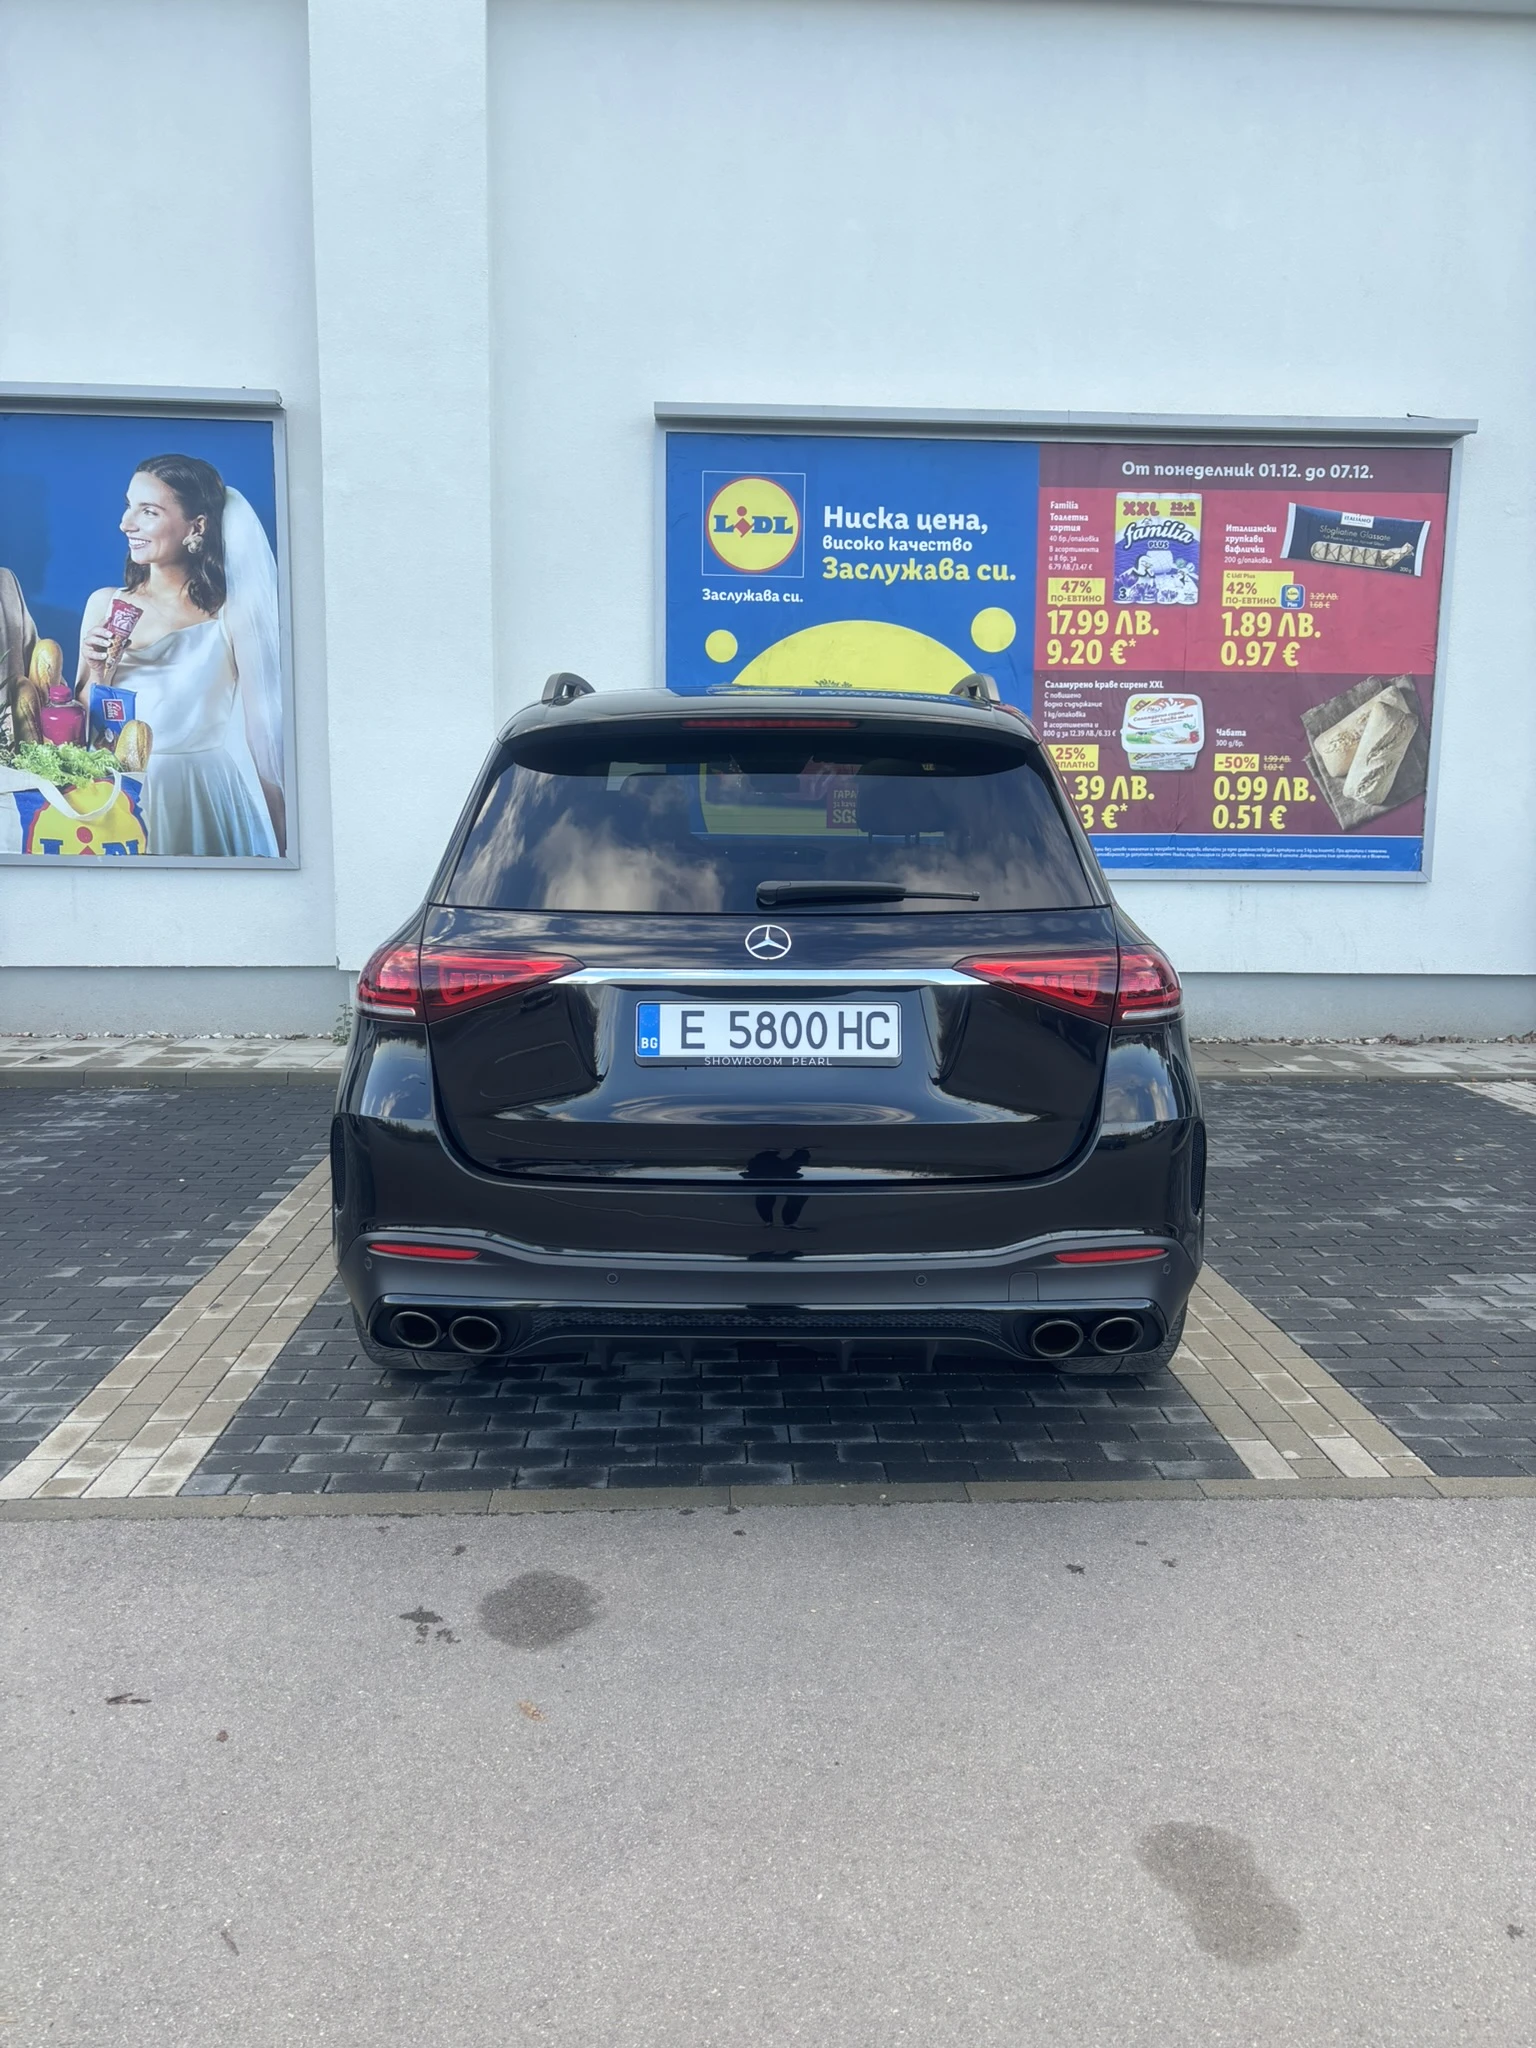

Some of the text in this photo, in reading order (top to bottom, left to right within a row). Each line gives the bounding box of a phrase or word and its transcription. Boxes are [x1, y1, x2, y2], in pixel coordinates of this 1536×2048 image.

[1122, 461, 1374, 481] От понеделник 01.12. до 07.12.
[1050, 501, 1079, 509] Familia
[1123, 501, 1160, 516] XXL
[823, 505, 988, 534] Ниска цена,
[1049, 513, 1089, 521] Тоалетна
[1049, 525, 1081, 533] хартия
[1124, 520, 1194, 550] familia
[1225, 524, 1277, 532] Италиански
[822, 535, 973, 552] високо качество
[1148, 541, 1170, 549] PLUS
[1225, 535, 1263, 544] хрупкави
[1225, 544, 1265, 554] вафлички
[822, 556, 1016, 585] Заслужава си.
[1061, 580, 1092, 594] 47%
[1226, 581, 1257, 595] 42%
[702, 588, 804, 604] Заслужава си.
[1225, 597, 1277, 605] ПО-ЕВТИНО
[1047, 609, 1160, 636] 17.99 ЛВ.
[1221, 611, 1321, 638] 1.89 ЛВ.
[1047, 639, 1103, 665] 9.20
[1220, 640, 1301, 667] 0.97 €
[1044, 680, 1164, 690] Саламурено краве сирене XXL
[1216, 728, 1246, 736] Чабата
[1055, 747, 1086, 760] 25%
[1218, 756, 1256, 769] -50%
[833, 790, 857, 799] ГАРА
[1110, 775, 1155, 801] ЛВ.
[1213, 775, 1317, 802] 0.99 ЛВ.
[1212, 804, 1288, 830] 0.51 €
[680, 1010, 890, 1050] E 5800 HC
[641, 1037, 658, 1049] BG
[704, 1056, 832, 1066] SHOWROOM PEARL
